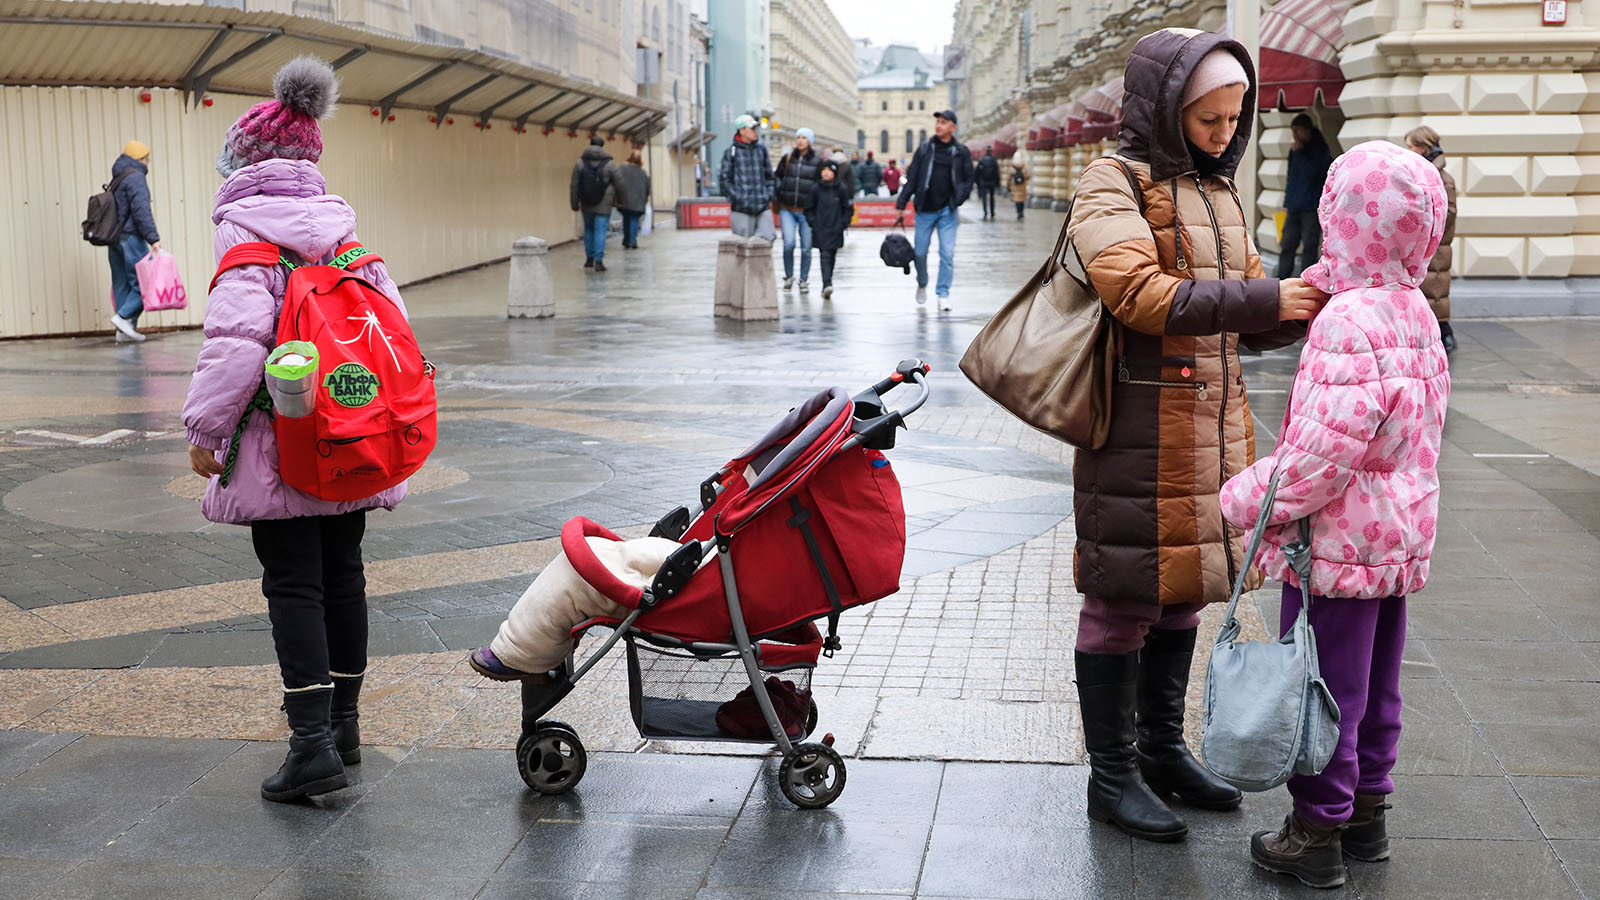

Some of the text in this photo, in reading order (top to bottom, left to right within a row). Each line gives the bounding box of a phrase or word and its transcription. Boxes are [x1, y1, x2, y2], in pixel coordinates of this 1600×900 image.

[155, 279, 186, 303] wb
[327, 374, 378, 386] АЛЬФА
[334, 384, 373, 396] БАНК
